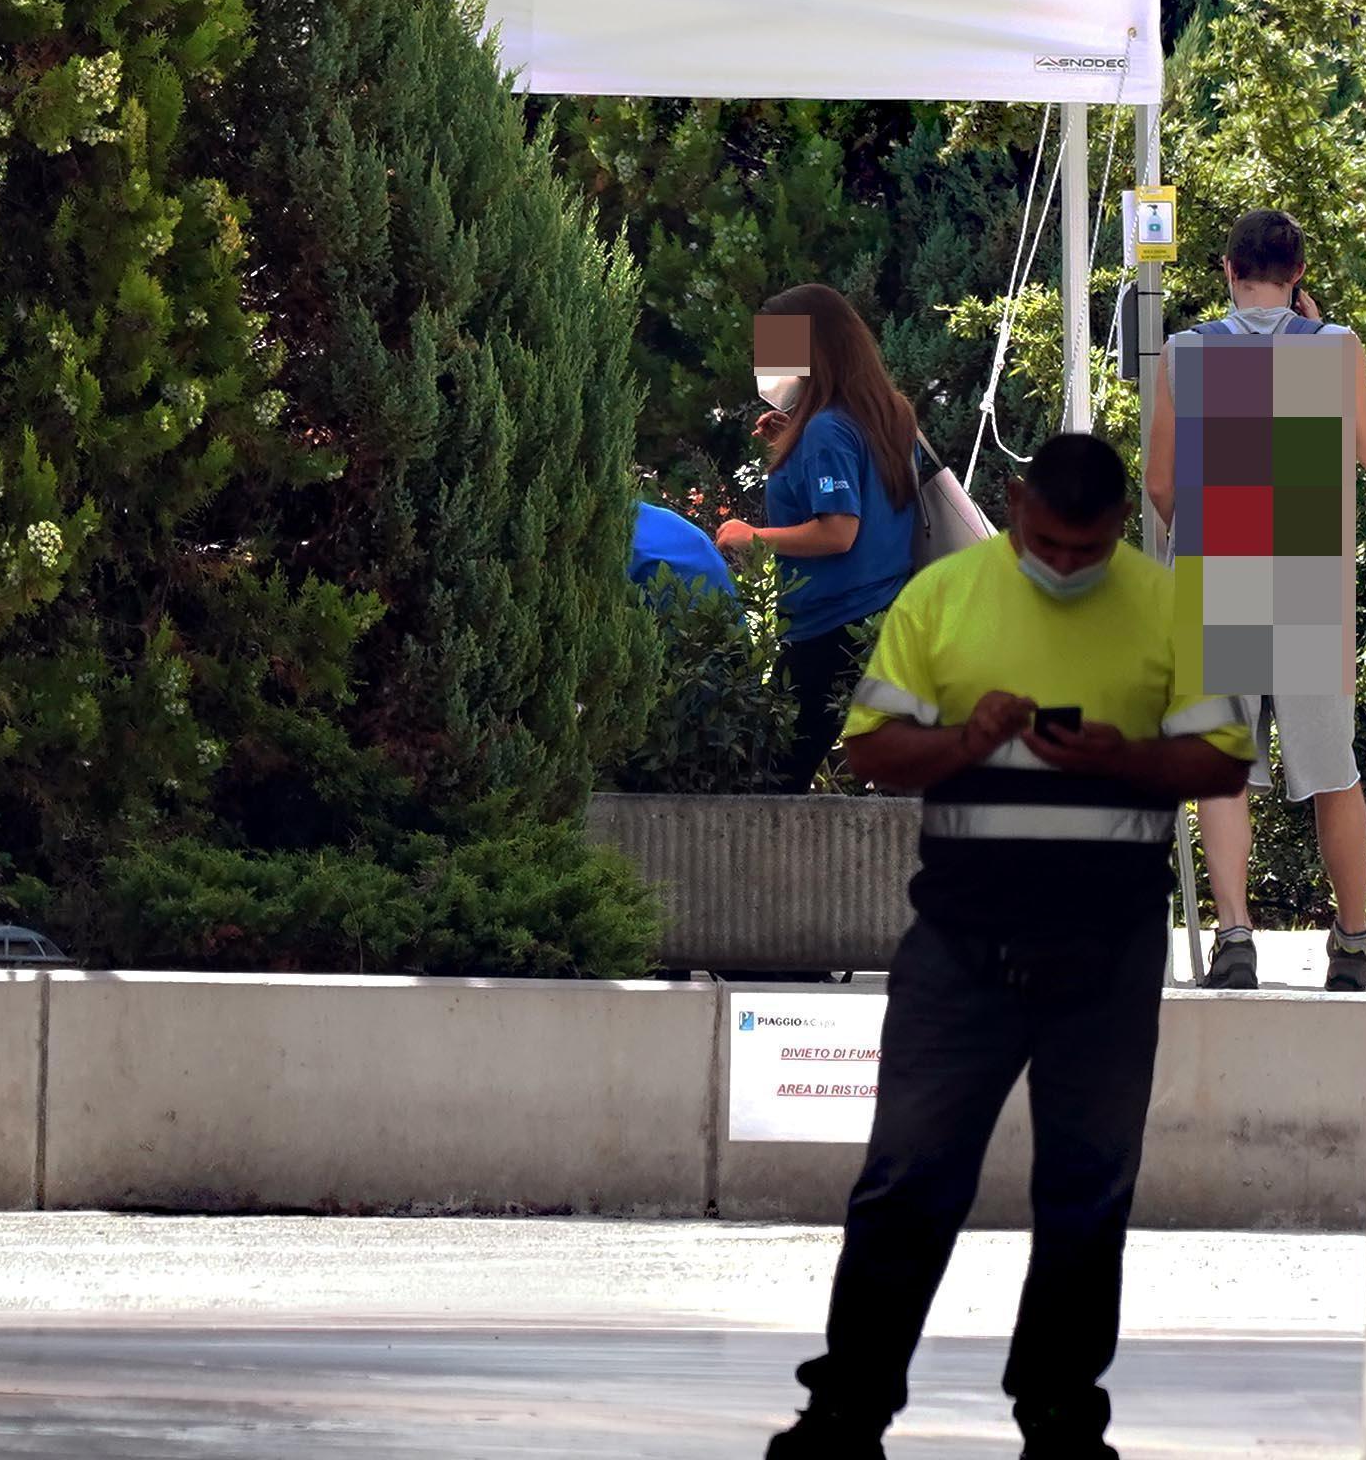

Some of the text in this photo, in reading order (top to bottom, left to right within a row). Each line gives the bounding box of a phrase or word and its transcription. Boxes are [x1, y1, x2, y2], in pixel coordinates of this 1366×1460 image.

[757, 1017, 803, 1027] PIAGGIO
[781, 1047, 831, 1059] DIVIETO
[833, 1048, 847, 1059] DI
[777, 1083, 812, 1095] AREA
[815, 1084, 829, 1095] DI
